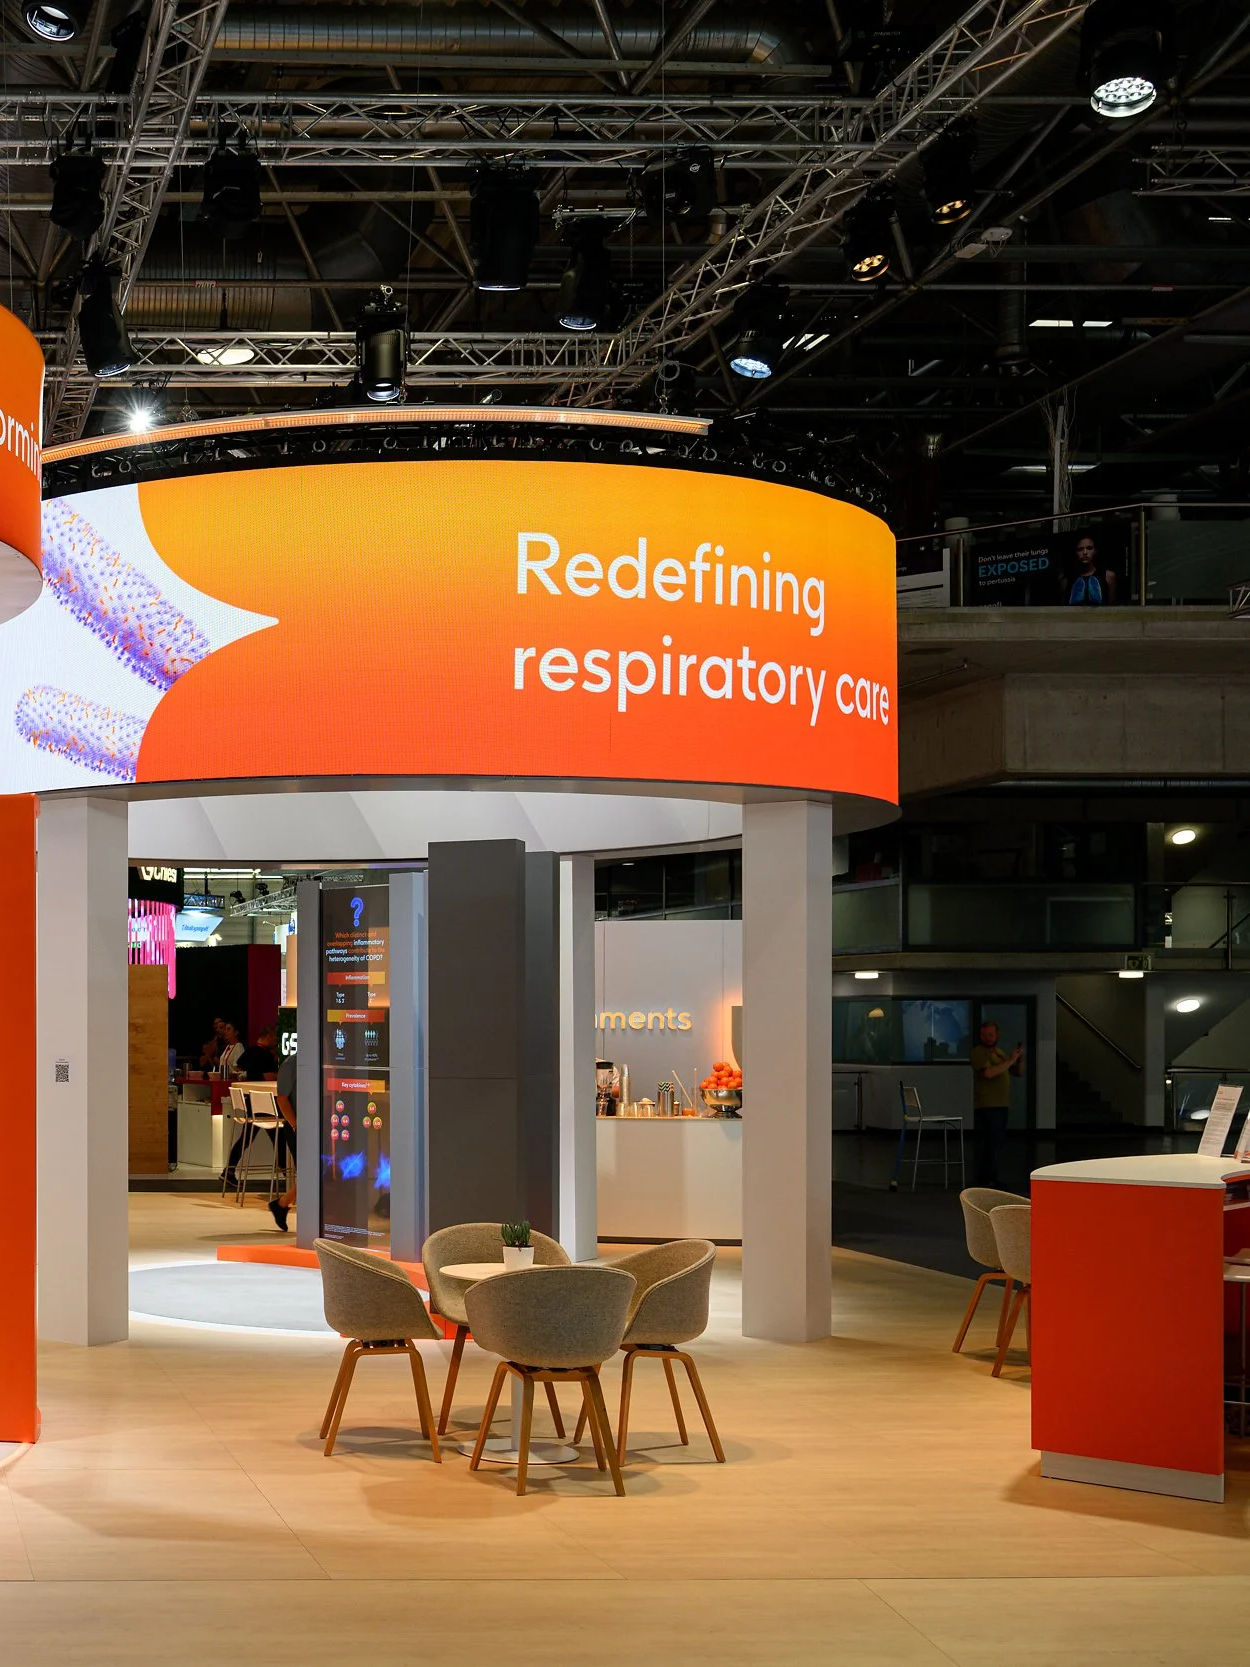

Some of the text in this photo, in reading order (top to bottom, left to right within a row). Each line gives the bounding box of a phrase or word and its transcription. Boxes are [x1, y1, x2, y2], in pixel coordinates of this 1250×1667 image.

[978, 548, 1049, 563] Don't leave their lungs
[978, 557, 1049, 578] EXPOSED
[516, 532, 825, 636] Redefining
[987, 576, 1016, 586] pertussis
[514, 635, 889, 727] respiratory care
[595, 1007, 692, 1030] ments
